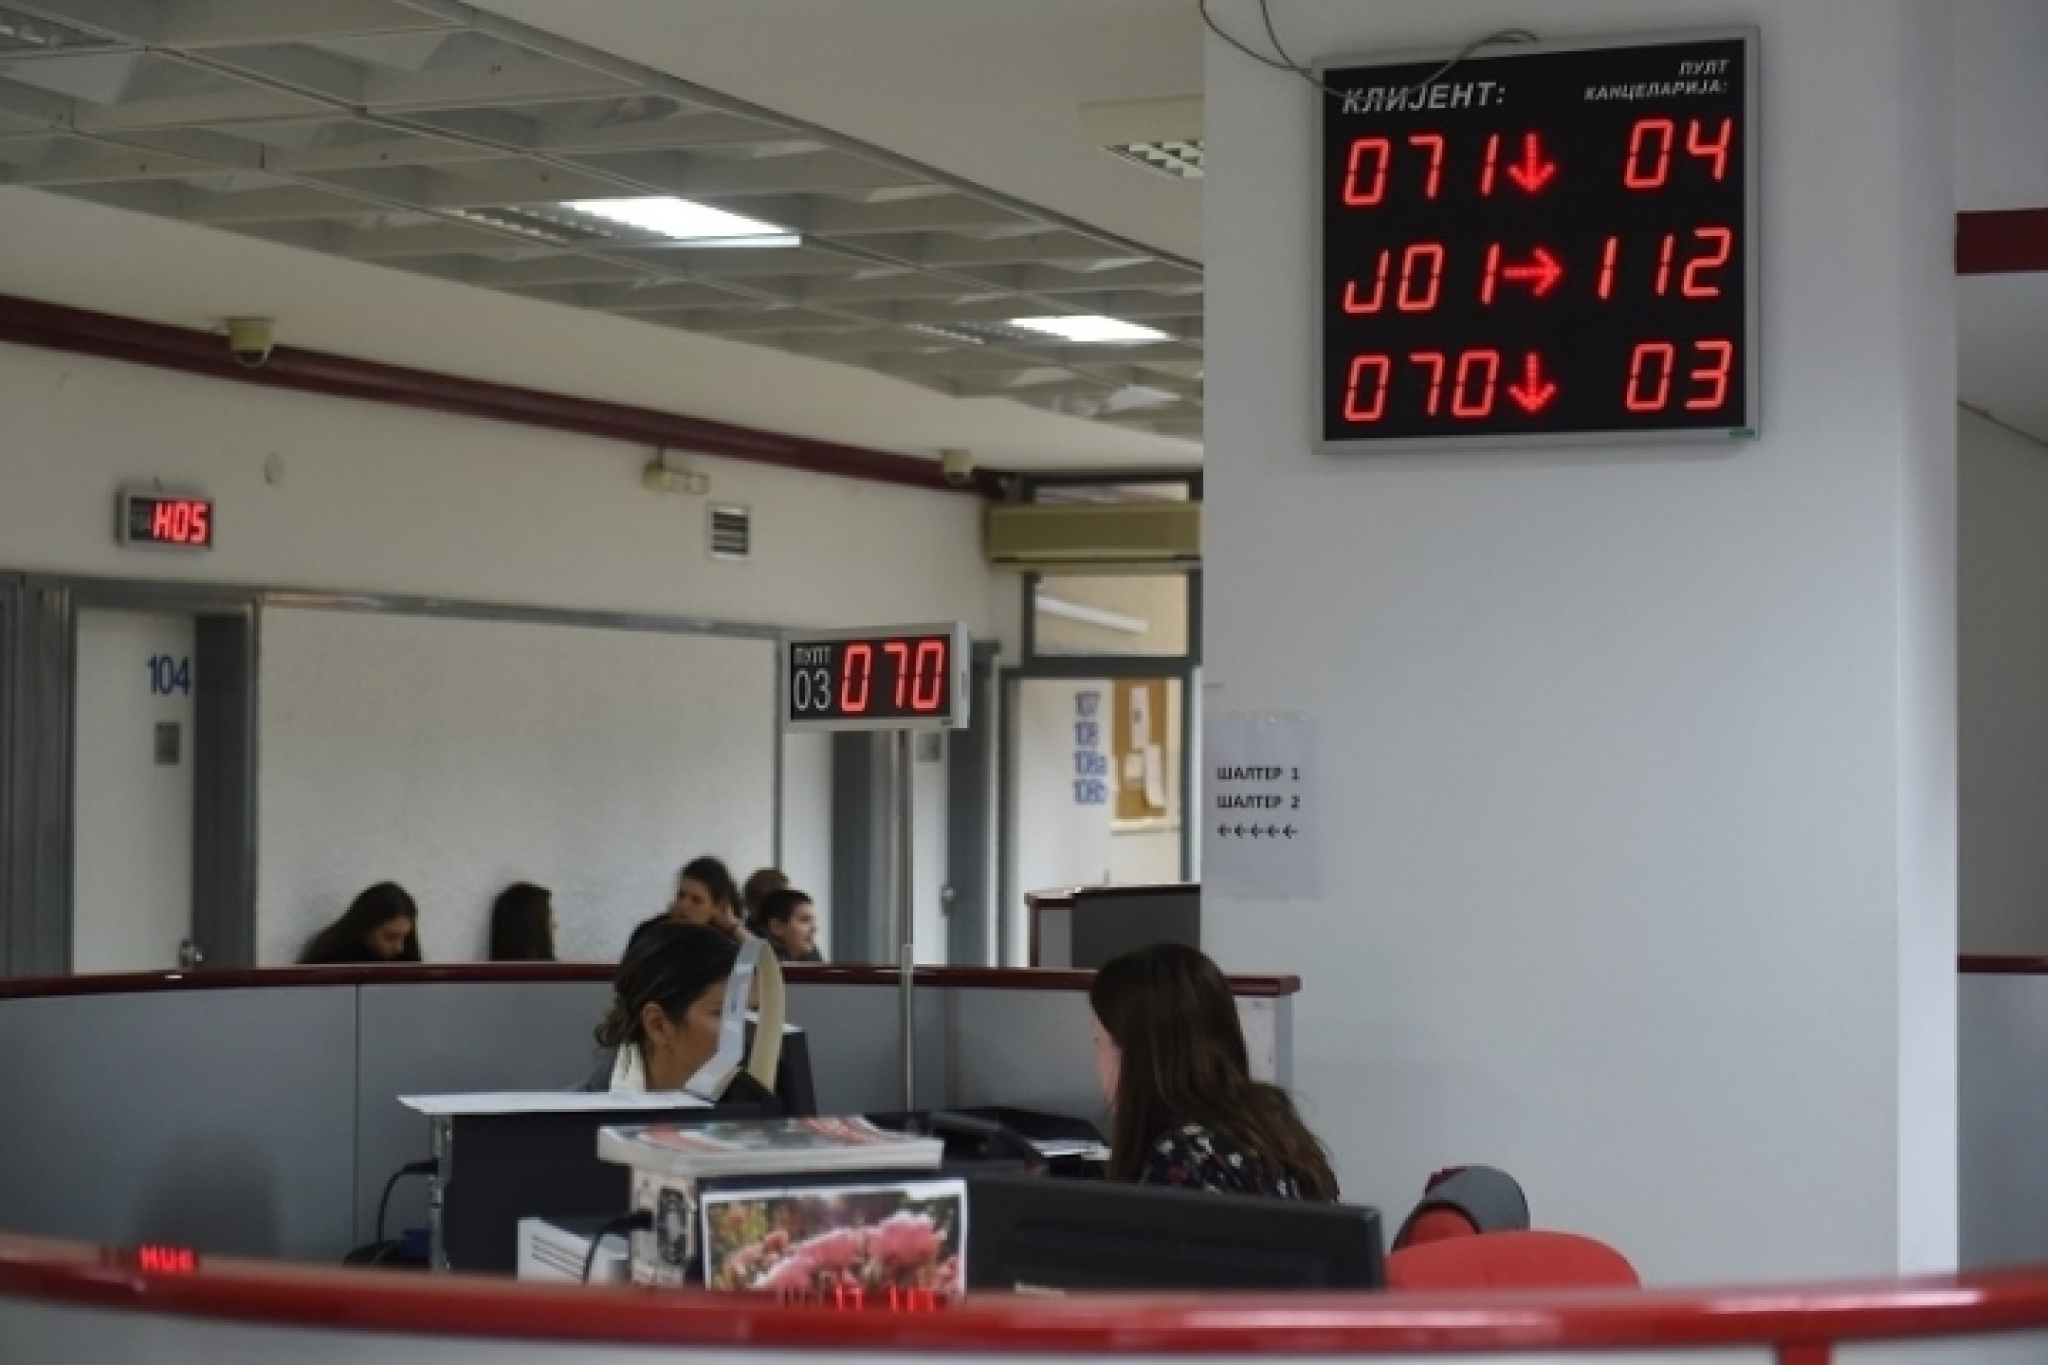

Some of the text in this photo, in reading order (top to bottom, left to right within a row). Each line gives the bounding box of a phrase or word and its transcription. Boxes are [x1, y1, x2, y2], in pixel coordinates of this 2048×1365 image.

[1678, 59, 1730, 77] ПУЛТ
[1342, 81, 1506, 114] КЛИЈЕНТ:
[1342, 117, 1733, 206] 071 04
[1599, 227, 1732, 299] 112
[1343, 340, 1733, 422] 070 03
[146, 654, 191, 697] 104
[793, 640, 945, 711] 03 070
[1217, 766, 1301, 781] ШАЛТЕР 1
[1217, 794, 1301, 809] ШАЛТЕР 2
